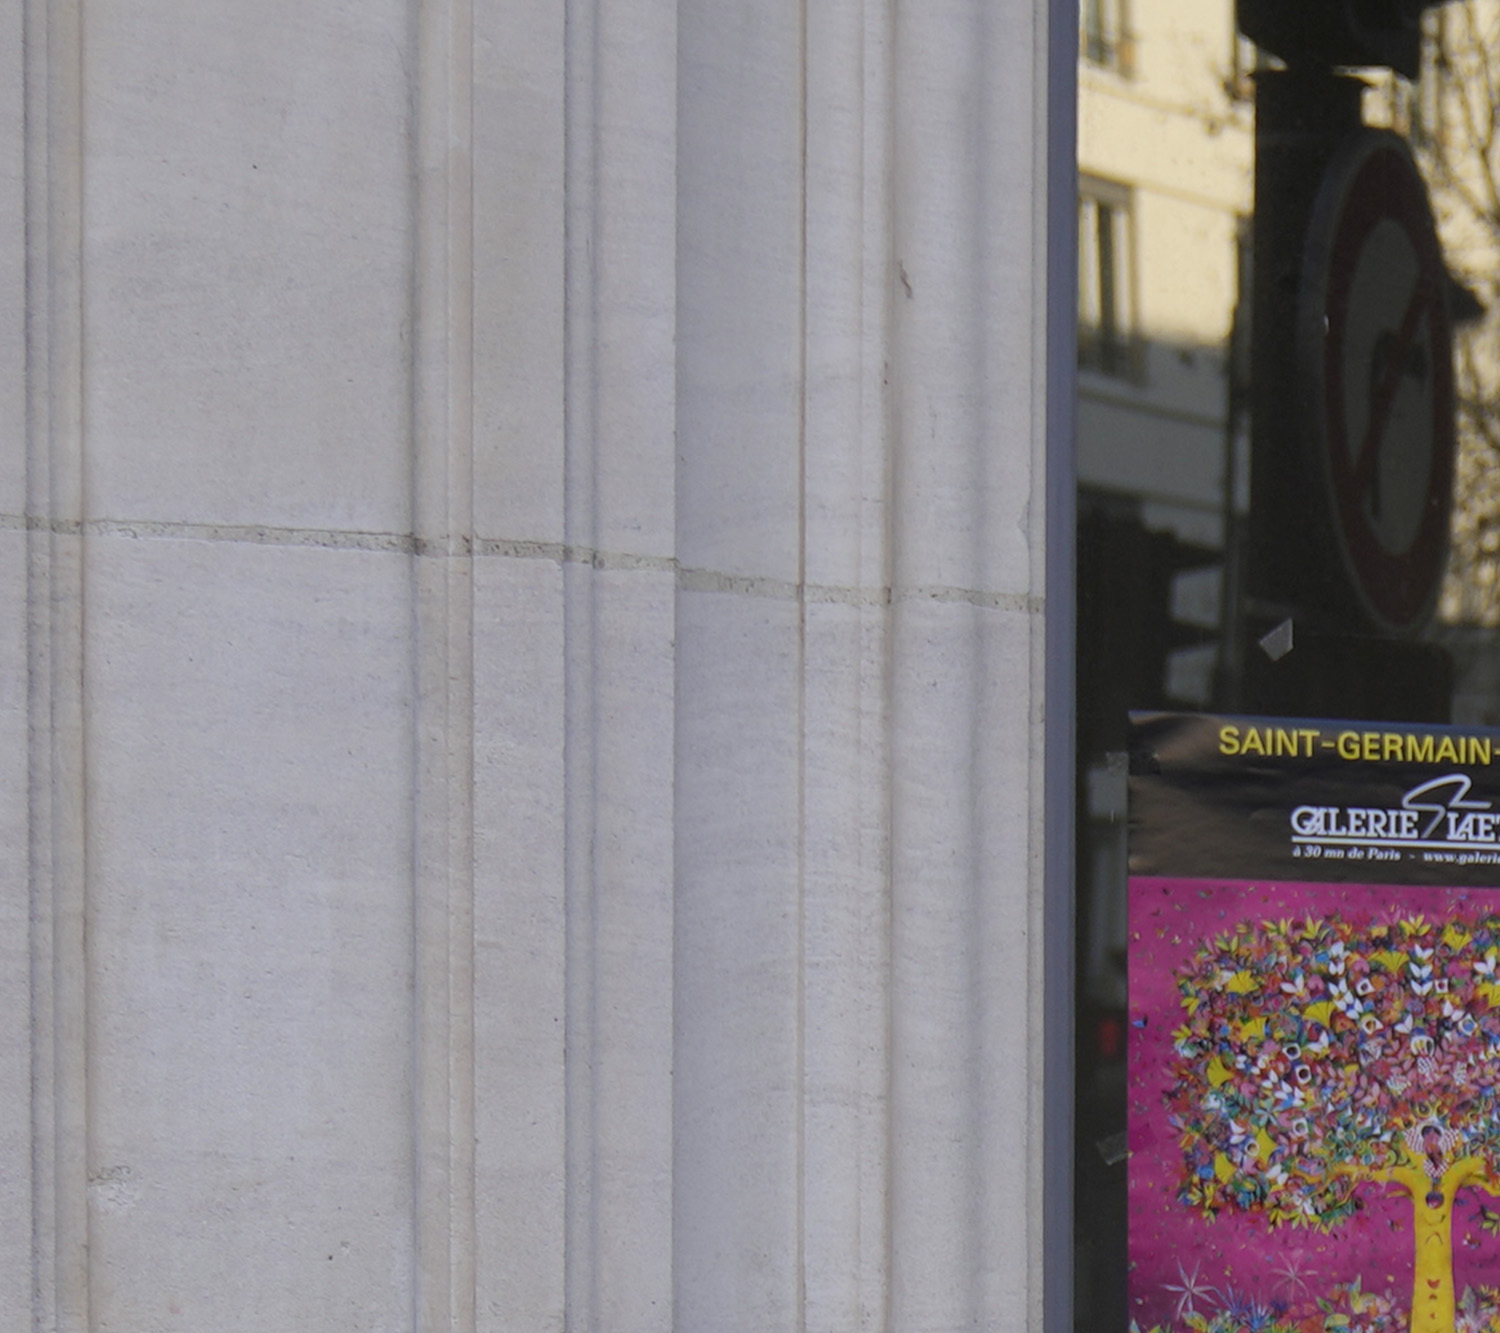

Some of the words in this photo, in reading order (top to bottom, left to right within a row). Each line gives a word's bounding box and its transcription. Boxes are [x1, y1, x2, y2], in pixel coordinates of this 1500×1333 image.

[1291, 805, 1419, 839] GALERIE
[1304, 846, 1320, 858] 30
[1324, 849, 1344, 859] mn
[1348, 848, 1364, 860] de
[1368, 849, 1400, 861] Paris
